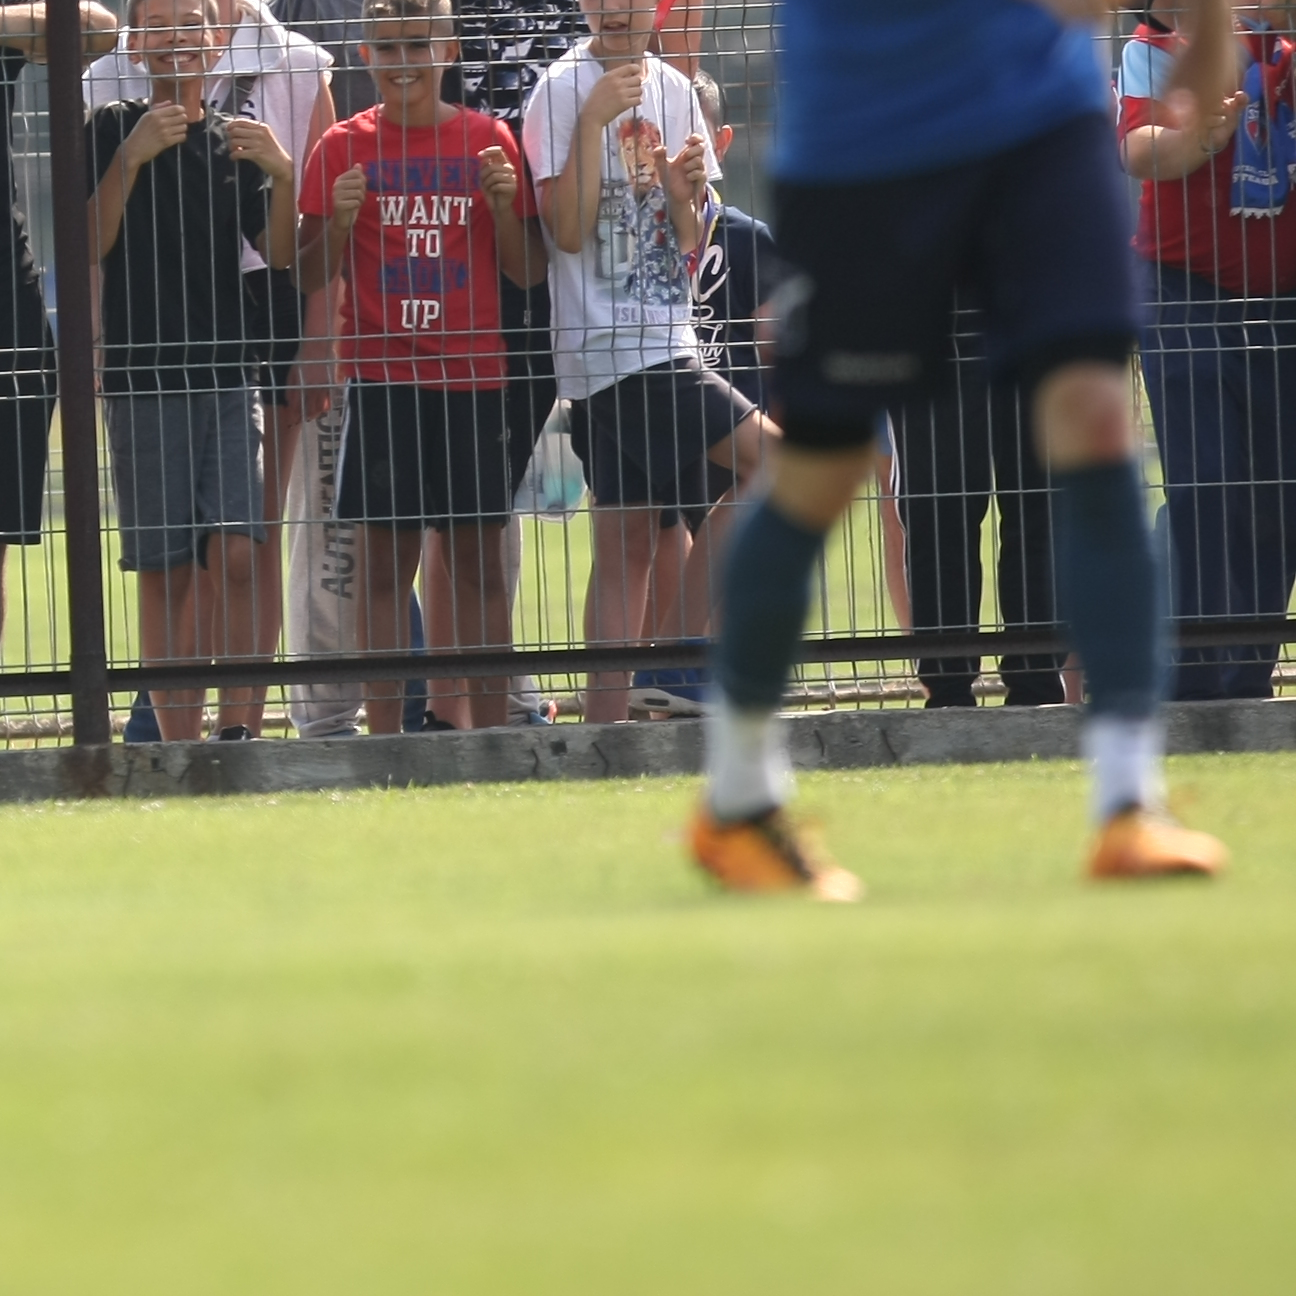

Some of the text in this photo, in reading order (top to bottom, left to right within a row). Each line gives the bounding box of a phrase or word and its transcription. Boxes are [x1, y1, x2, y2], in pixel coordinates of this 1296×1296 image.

[376, 195, 472, 225] WANT
[406, 229, 442, 257] TO
[400, 299, 440, 329] UP
